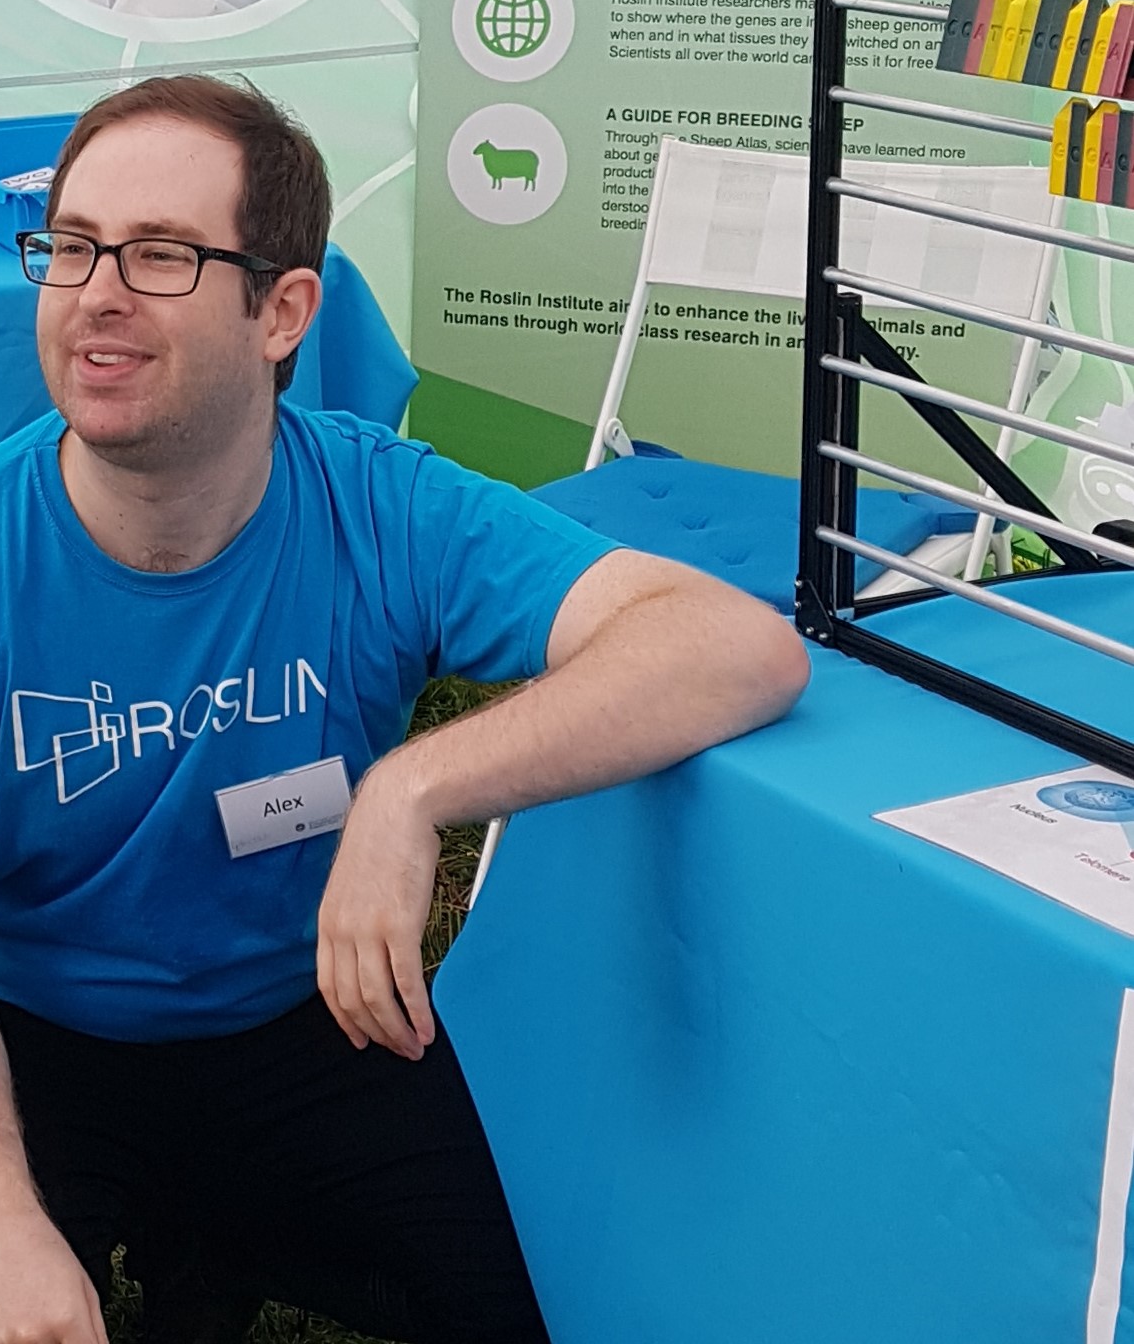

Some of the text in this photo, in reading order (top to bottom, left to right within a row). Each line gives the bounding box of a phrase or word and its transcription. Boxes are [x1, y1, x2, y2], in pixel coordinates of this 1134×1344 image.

[611, 11, 802, 28] to show where the genes are
[848, 18, 890, 34] sheep
[610, 28, 809, 48] when and in what tissues they
[903, 41, 921, 52] on
[609, 46, 788, 63] Scientists all over the world
[873, 55, 903, 68] it for
[606, 108, 803, 128] A GUIDE FOR BREEDING
[605, 130, 658, 145] Through
[736, 136, 772, 151] Atlas,
[604, 149, 640, 161] about
[875, 143, 966, 158] learned more
[603, 183, 649, 196] into the
[444, 288, 781, 324] The Roslin Institute to enhance the
[444, 309, 778, 347] humans through research in
[931, 323, 965, 338] and
[130, 657, 327, 758] ROSLIN
[263, 795, 304, 818] Alex
[1009, 803, 1059, 824] Nucleus
[1073, 852, 1131, 882] Telomere
